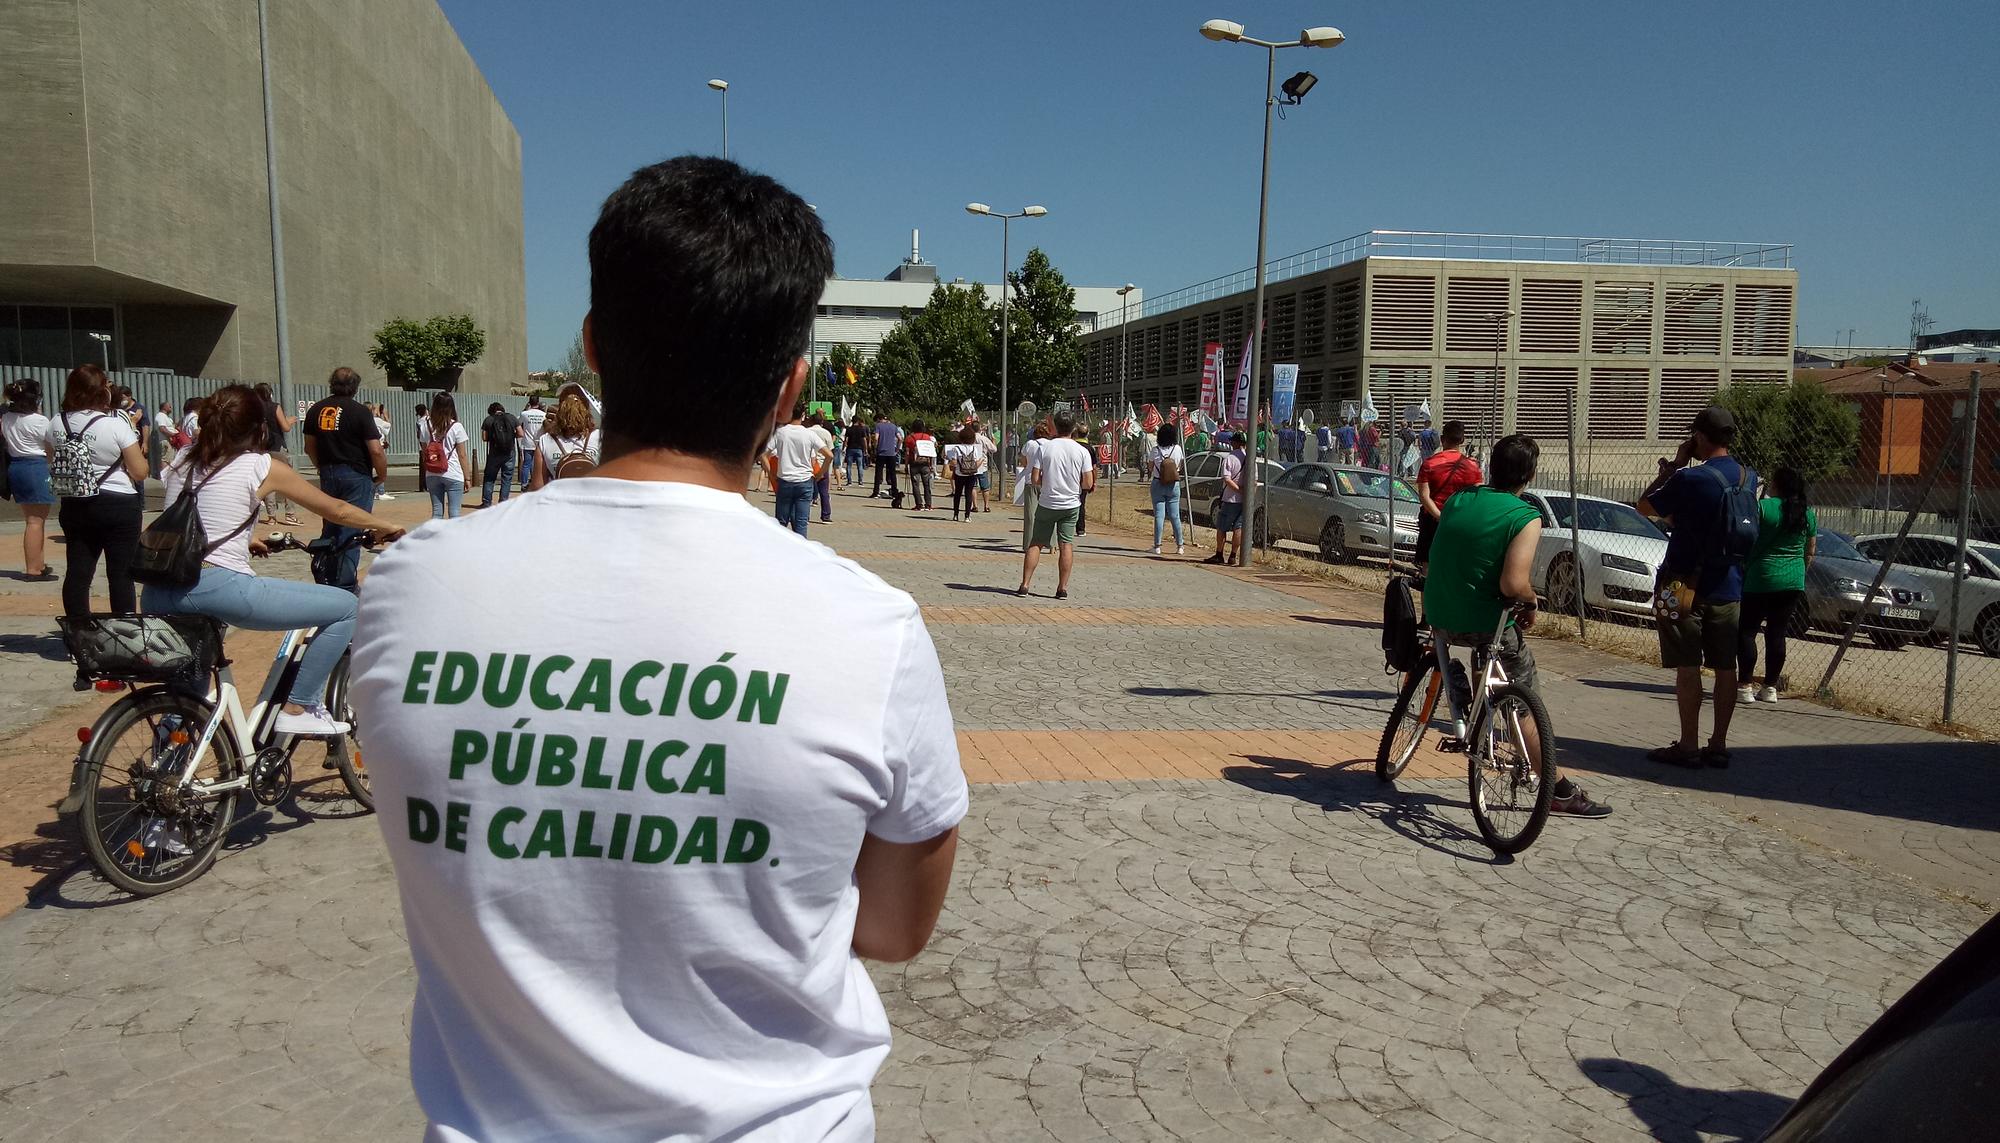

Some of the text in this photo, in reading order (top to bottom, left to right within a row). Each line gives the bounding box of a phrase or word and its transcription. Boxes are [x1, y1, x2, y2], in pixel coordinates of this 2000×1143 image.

[402, 650, 790, 725] EDUCACIÓN
[449, 718, 727, 795] PÚBLICA
[406, 797, 780, 868] DE CALIDAD.
